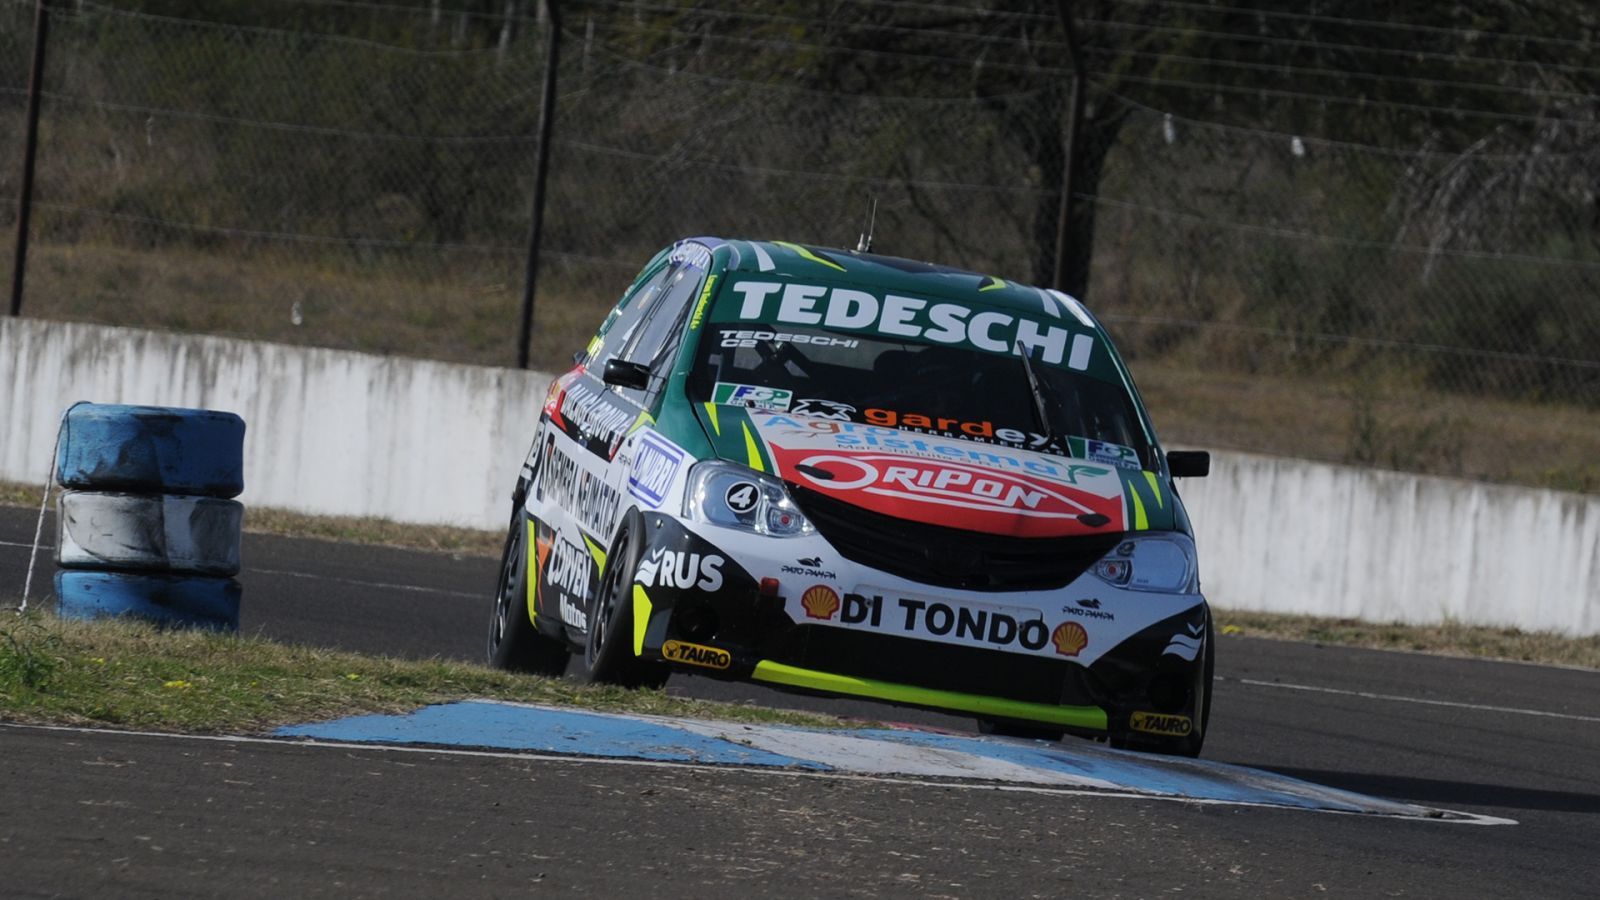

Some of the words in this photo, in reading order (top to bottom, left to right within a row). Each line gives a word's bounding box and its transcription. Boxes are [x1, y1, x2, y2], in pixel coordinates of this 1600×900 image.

[733, 281, 1094, 371] TEDESCHI
[719, 330, 859, 349] TEDESCHI
[720, 339, 758, 348] C2
[764, 415, 898, 437] Agro
[834, 434, 1058, 476] sistema
[729, 486, 754, 508] 4
[548, 528, 592, 607] CORVEN
[660, 550, 725, 592] RUS
[781, 565, 804, 575] PATO
[805, 569, 836, 580] PAMPA
[560, 592, 588, 634] Motos
[840, 593, 883, 627] DI
[898, 598, 1049, 651] TONDO
[679, 645, 729, 667] TAURO
[1143, 715, 1191, 734] TAURO
